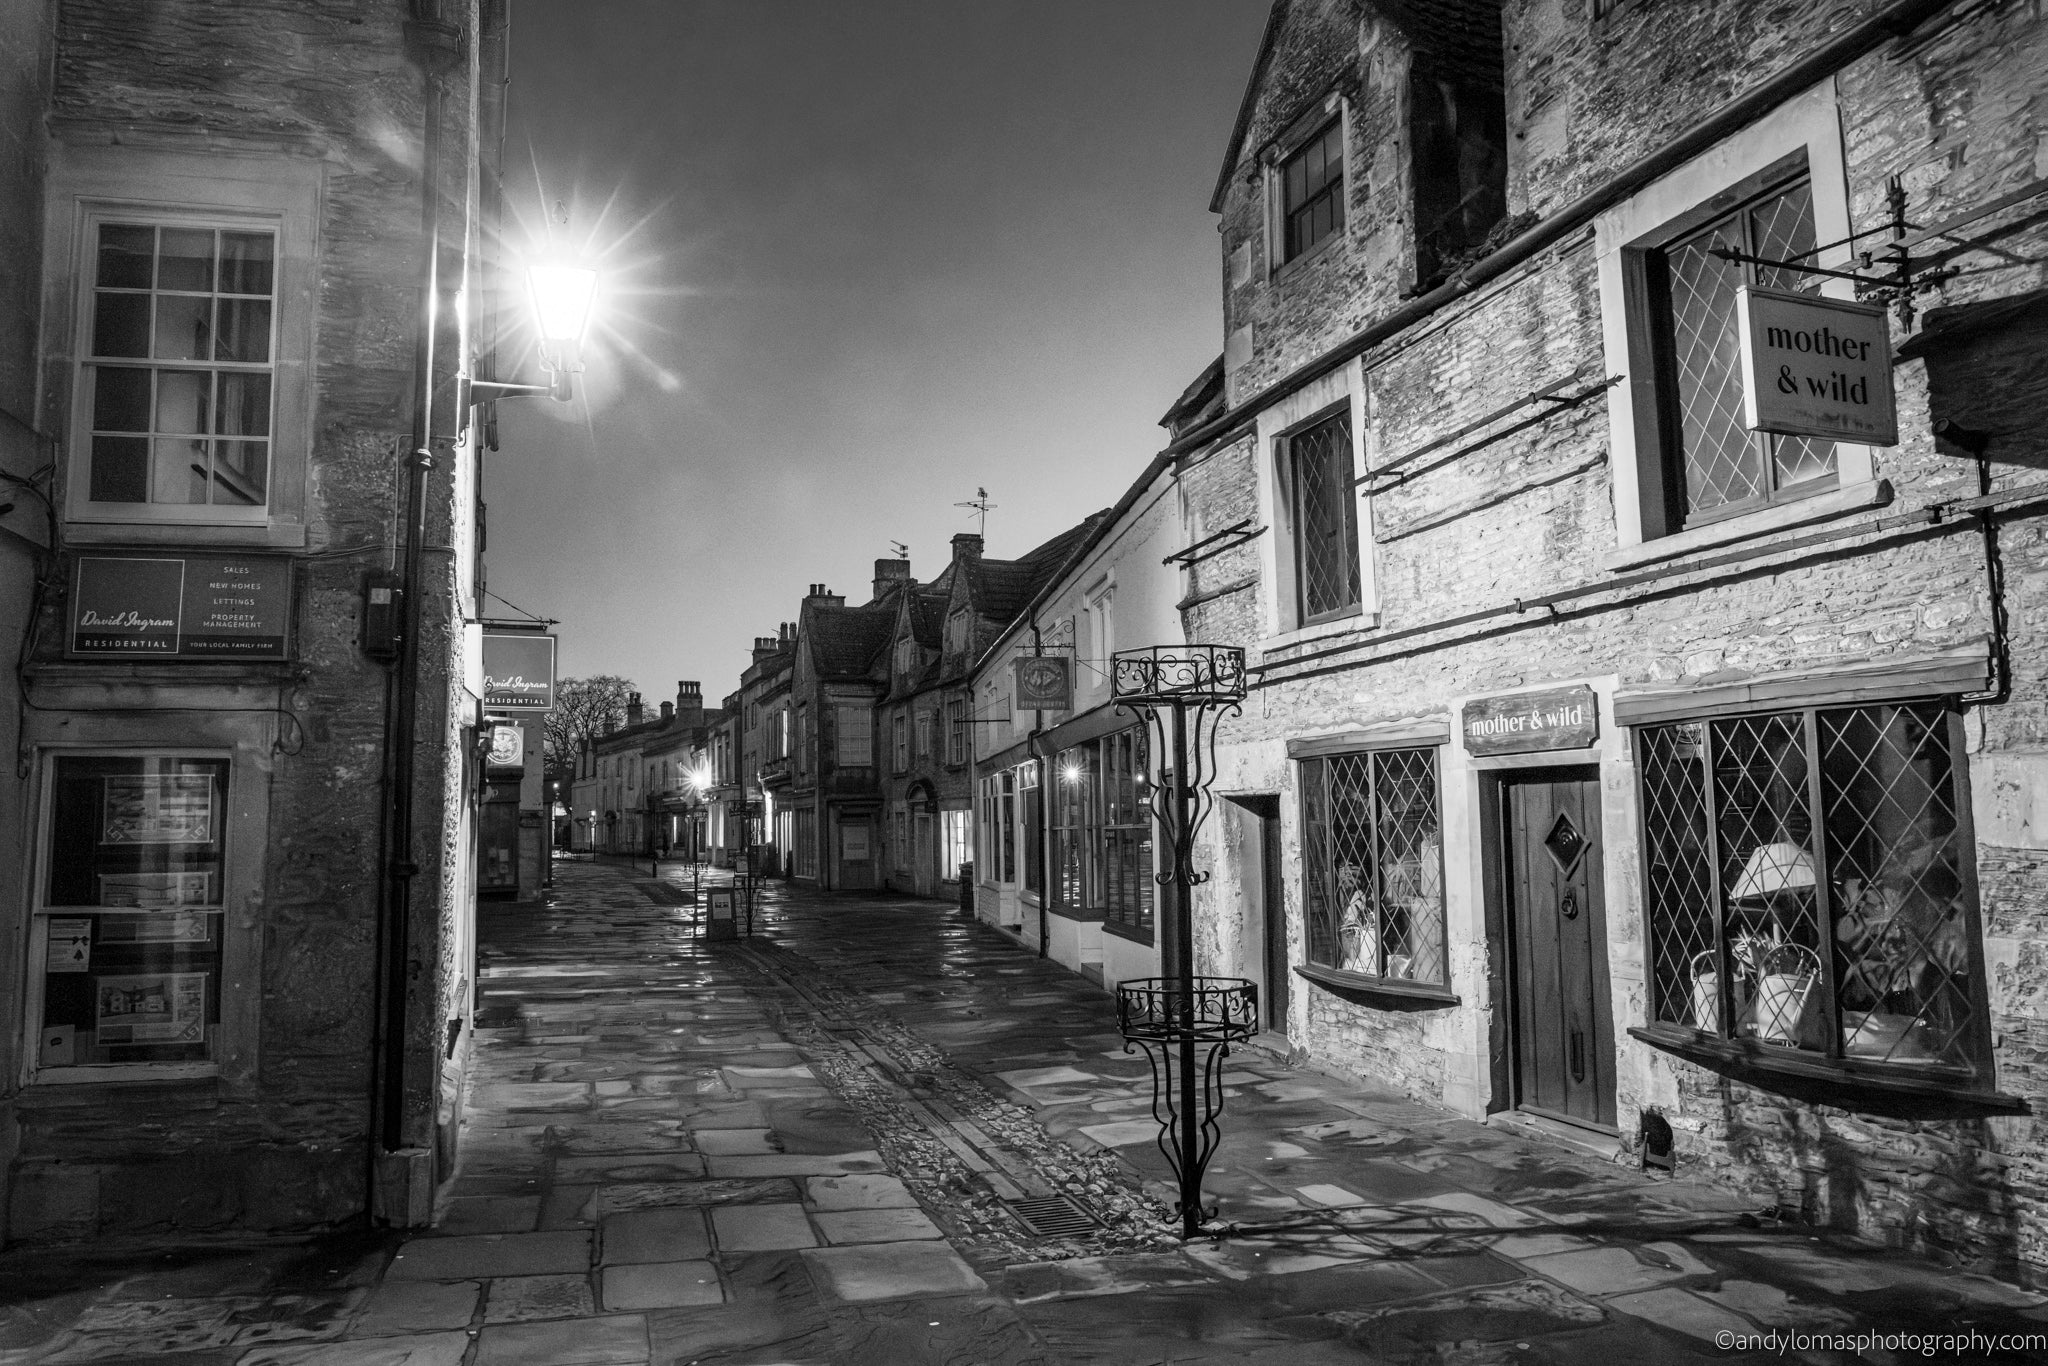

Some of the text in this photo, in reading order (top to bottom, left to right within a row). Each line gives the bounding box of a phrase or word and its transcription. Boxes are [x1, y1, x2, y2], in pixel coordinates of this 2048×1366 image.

[1767, 327, 1871, 361] mother
[1777, 364, 1868, 405] & wild
[223, 566, 250, 574] SALES
[213, 598, 255, 606] LETTINGS
[81, 610, 175, 631] David Ingram
[85, 640, 167, 648] RESIDENTIAL
[512, 675, 548, 692] Ingram
[485, 697, 545, 705] RESIDENTIAL
[1471, 704, 1583, 736] mother & wild
[106, 825, 125, 843] LET
[190, 824, 206, 840] LET
[183, 1025, 200, 1040] LET
